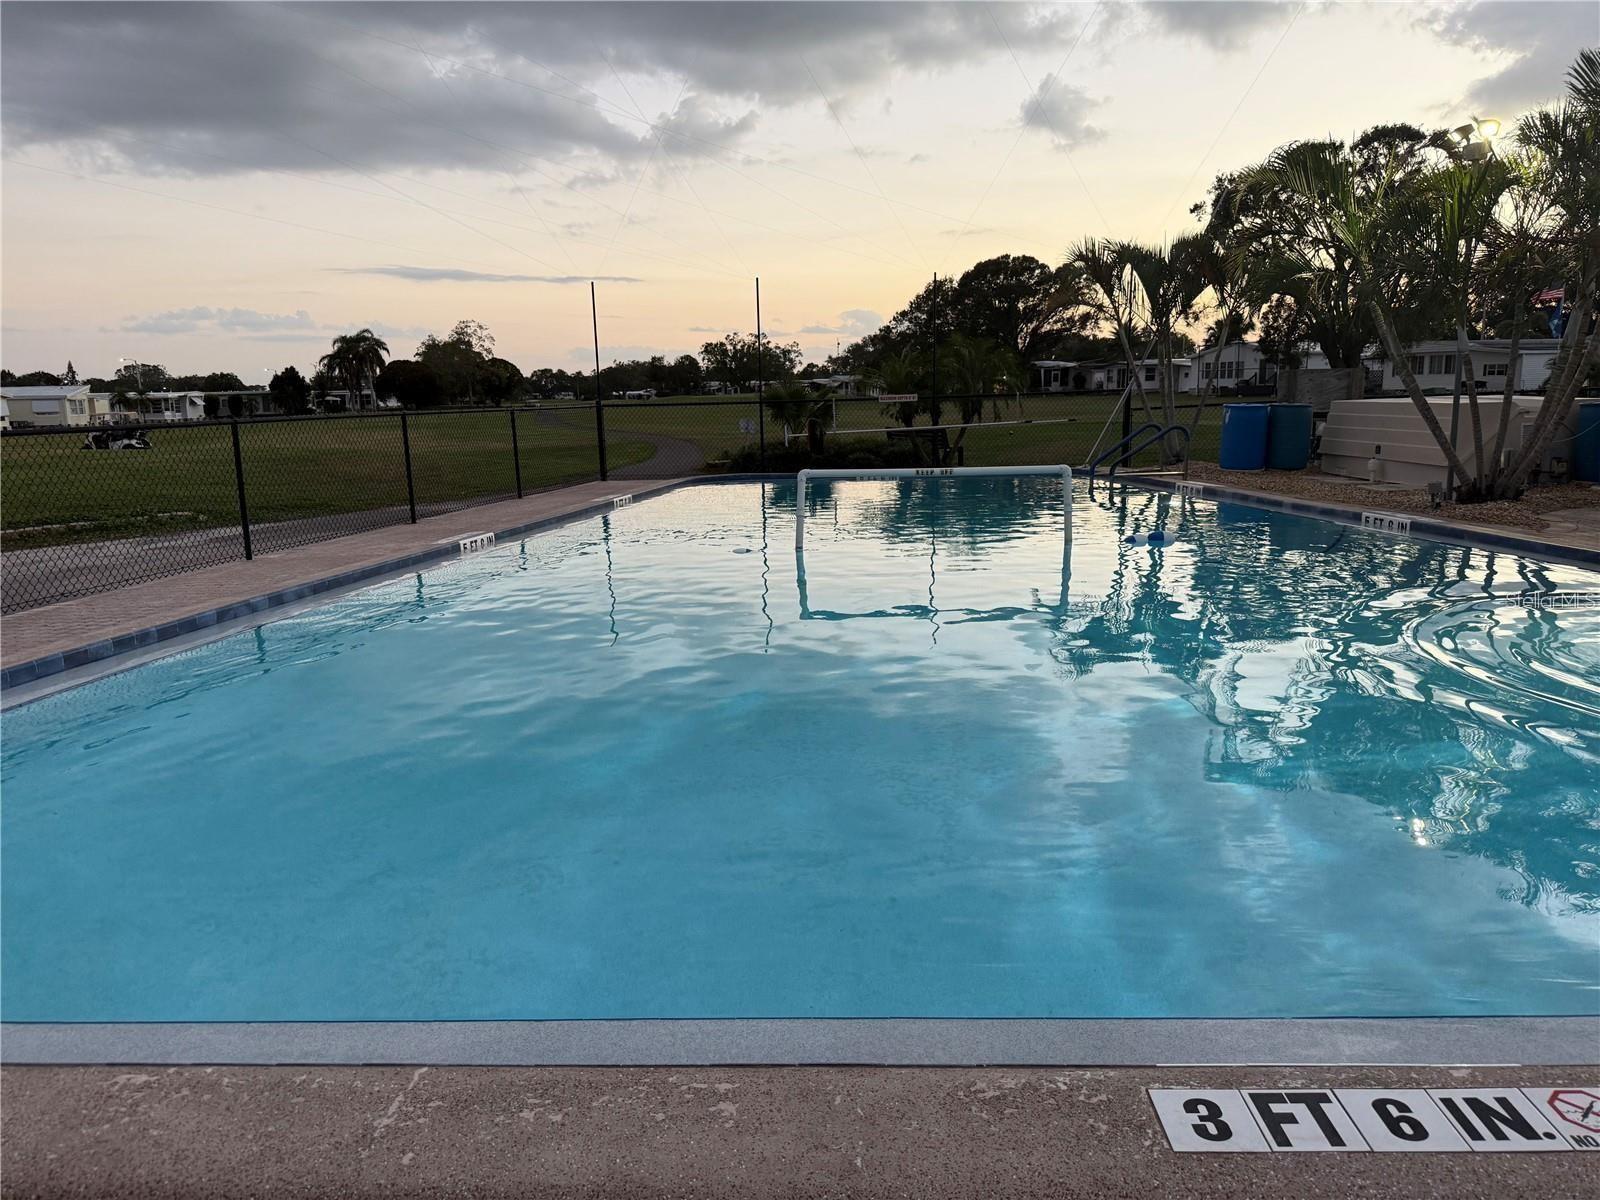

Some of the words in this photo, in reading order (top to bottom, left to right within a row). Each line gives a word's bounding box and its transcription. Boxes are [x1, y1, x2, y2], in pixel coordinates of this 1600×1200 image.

[1182, 1097, 1233, 1142] 3
[1247, 1092, 1348, 1147] FT
[1371, 1097, 1429, 1142] 6
[1438, 1096, 1558, 1141] IN.
[1569, 1134, 1600, 1148] NO
